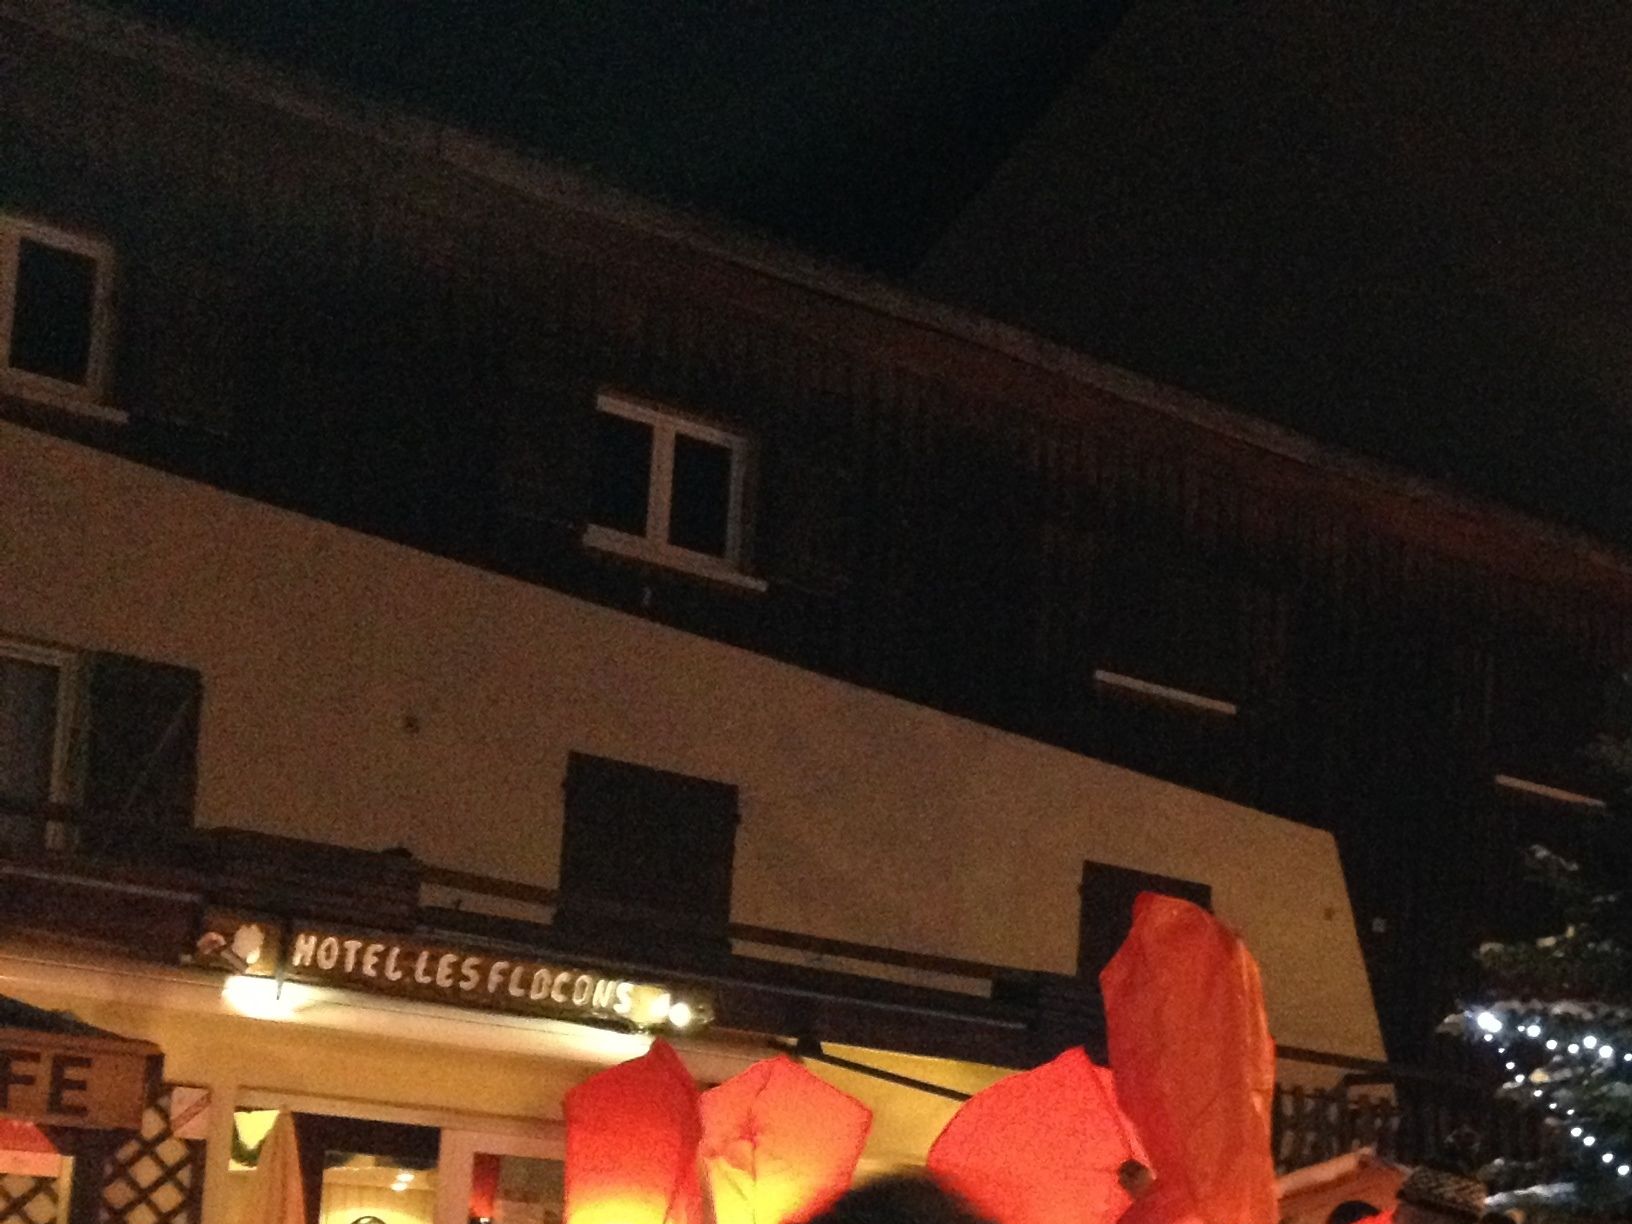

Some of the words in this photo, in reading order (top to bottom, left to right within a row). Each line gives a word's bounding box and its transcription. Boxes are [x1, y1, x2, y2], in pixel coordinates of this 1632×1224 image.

[292, 932, 402, 981] HOTEL
[414, 951, 481, 990] LES
[487, 961, 635, 1014] FLOCONS
[0, 1050, 92, 1116] FE
